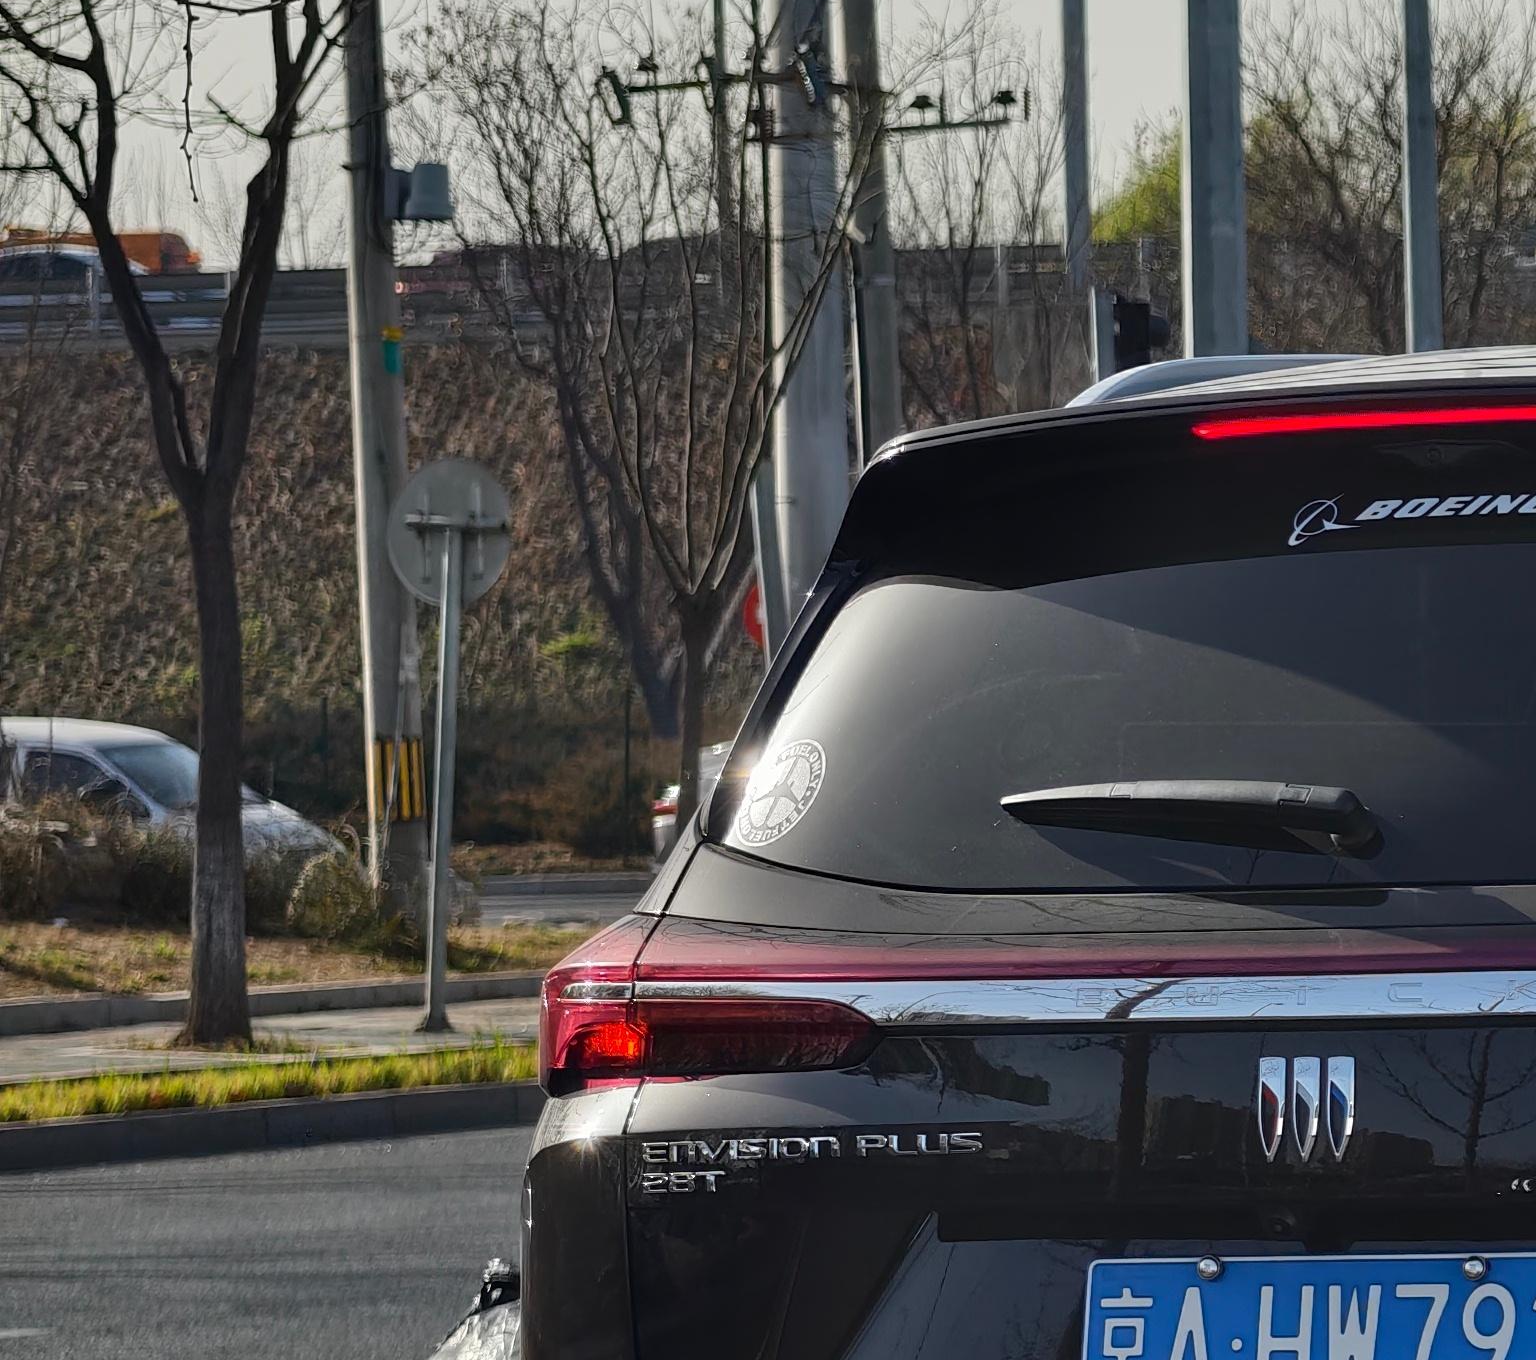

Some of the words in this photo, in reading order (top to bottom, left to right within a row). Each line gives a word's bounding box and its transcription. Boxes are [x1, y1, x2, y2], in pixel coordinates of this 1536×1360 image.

[642, 1136, 841, 1164] ENVISION
[856, 1132, 983, 1159] PLUS
[642, 1170, 726, 1193] 28T
